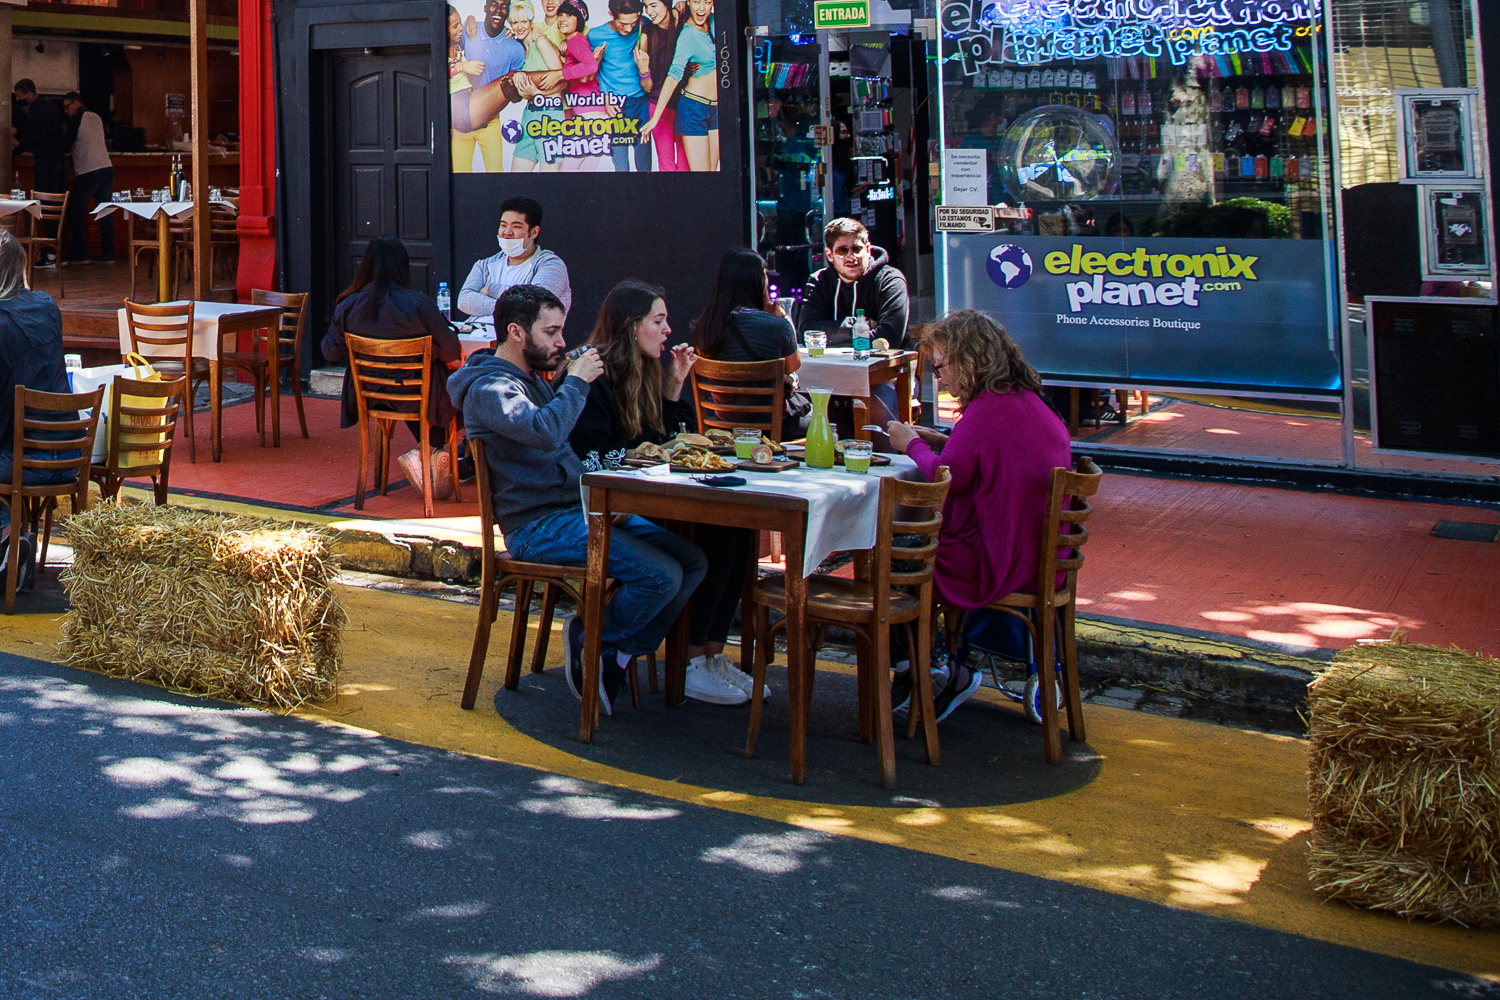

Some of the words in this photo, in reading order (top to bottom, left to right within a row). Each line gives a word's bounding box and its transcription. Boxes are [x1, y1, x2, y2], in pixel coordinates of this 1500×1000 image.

[819, 7, 866, 21] ENTRADA
[720, 31, 731, 89] 1686
[533, 94, 562, 107] One
[565, 93, 605, 106] World
[609, 92, 627, 108] by
[527, 113, 640, 137] electronix
[543, 134, 611, 161] planet
[1043, 244, 1259, 281] electronix
[1065, 274, 1200, 313] planet
[1056, 314, 1088, 325] Phone
[1089, 315, 1150, 328] Accessories
[1152, 317, 1201, 331] Boutique
